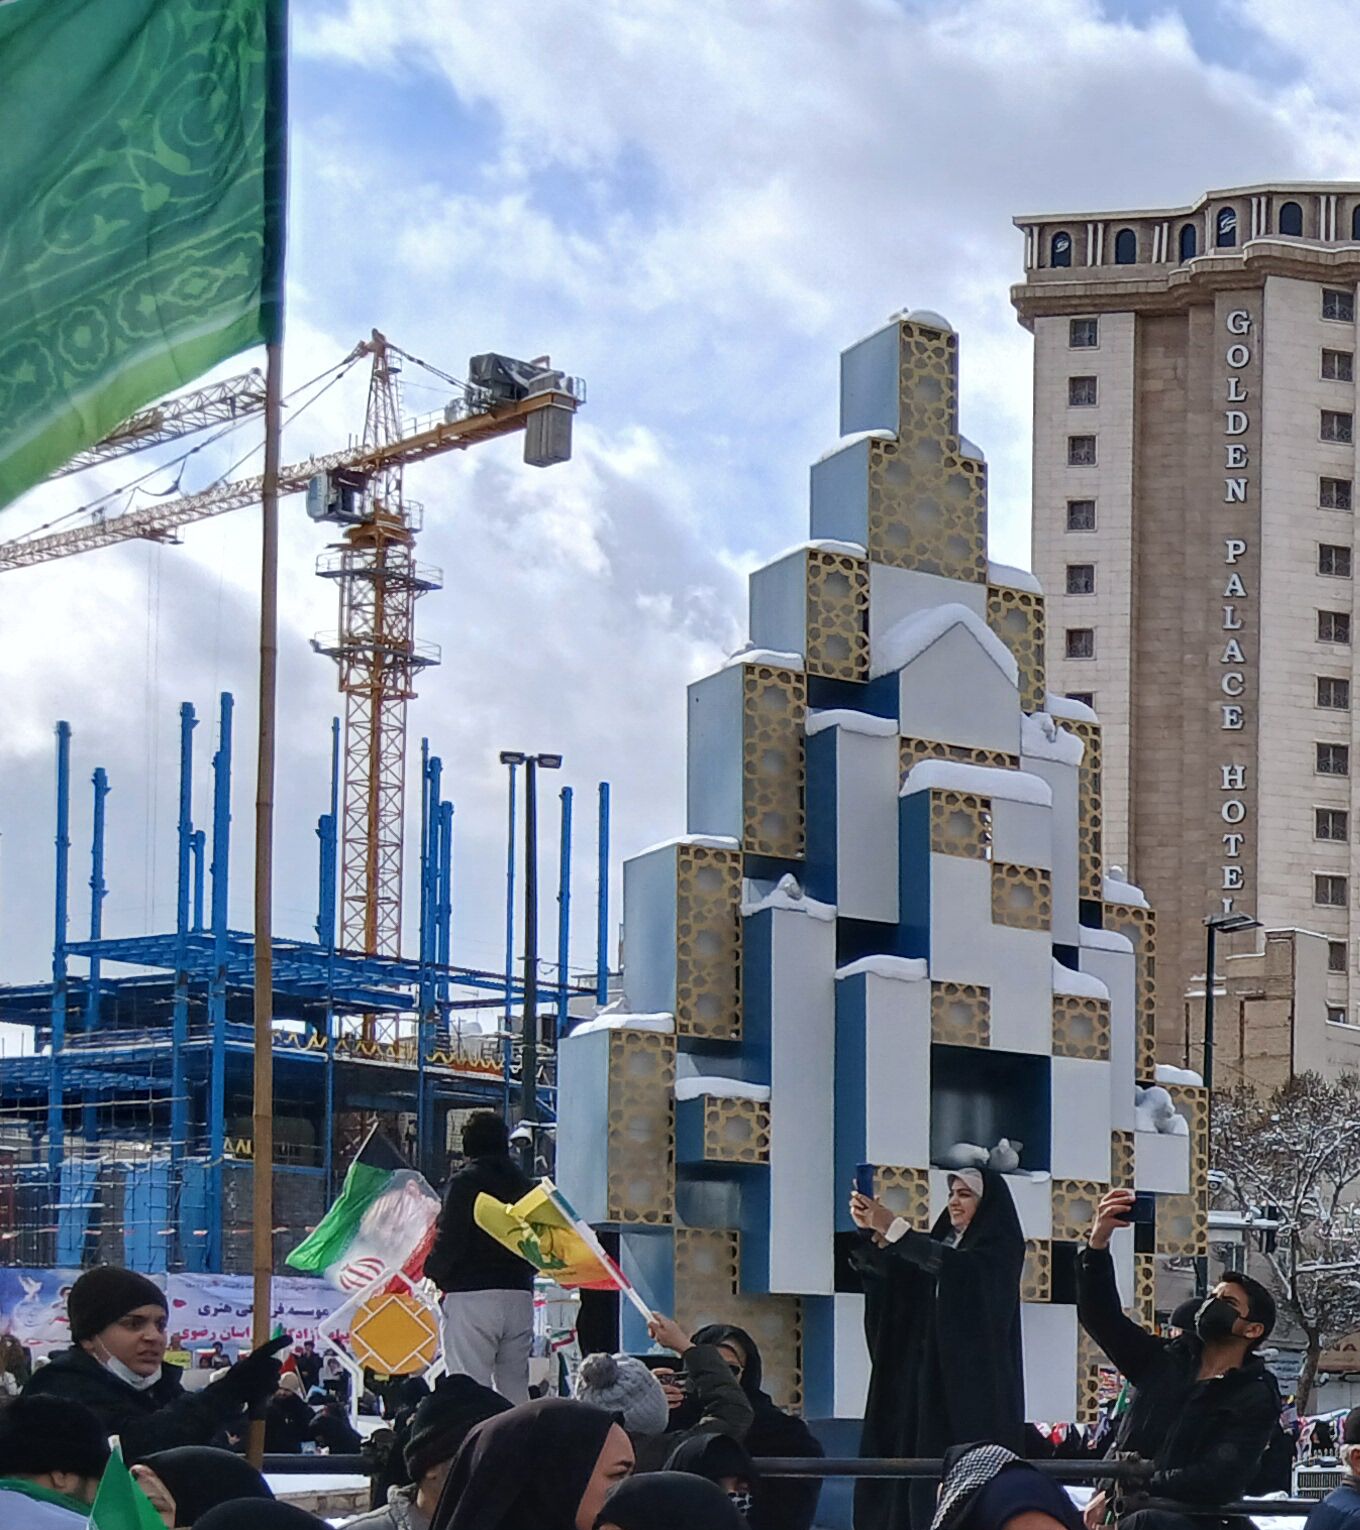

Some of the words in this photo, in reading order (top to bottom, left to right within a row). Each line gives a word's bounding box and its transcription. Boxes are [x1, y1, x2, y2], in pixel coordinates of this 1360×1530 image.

[1224, 309, 1250, 503] GOLDEN
[1221, 539, 1246, 731] PALACE
[198, 1302, 232, 1317] هنری
